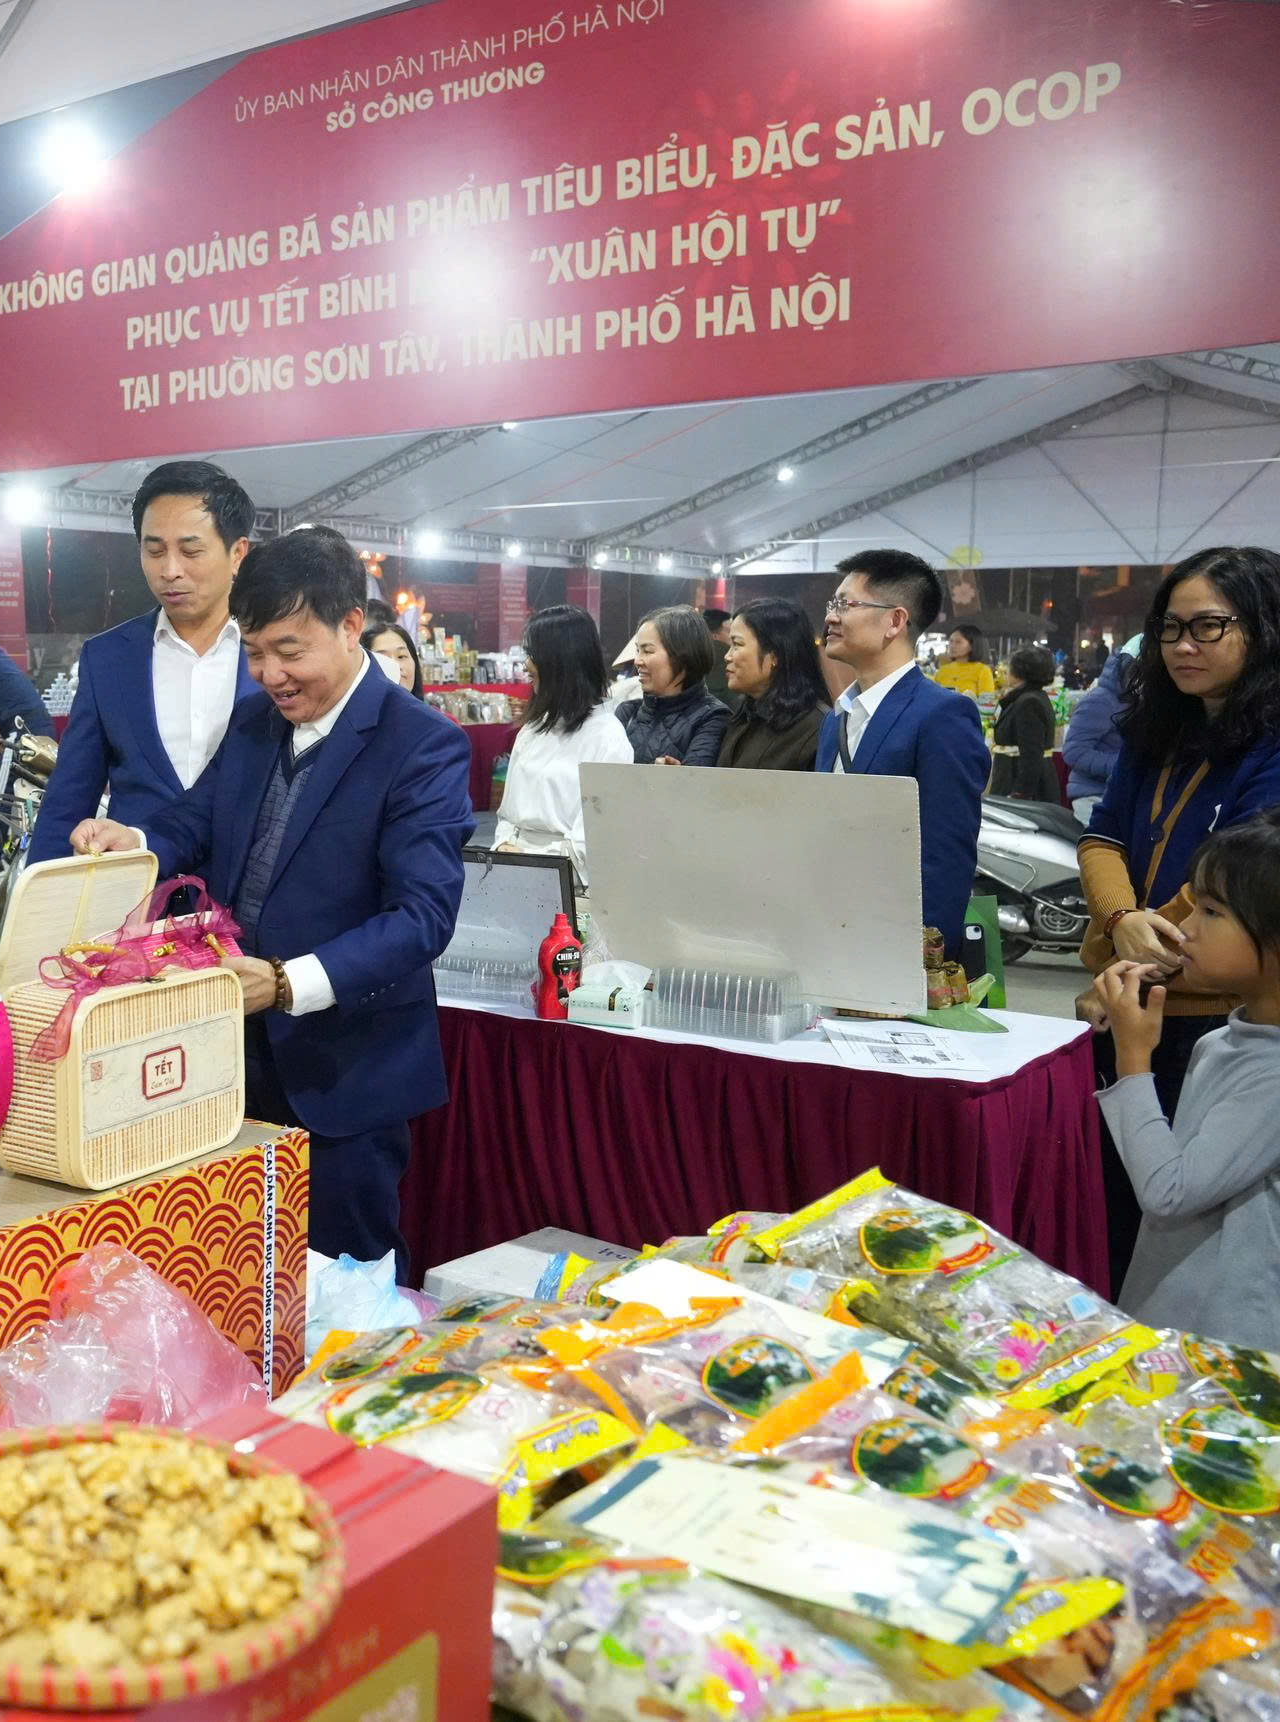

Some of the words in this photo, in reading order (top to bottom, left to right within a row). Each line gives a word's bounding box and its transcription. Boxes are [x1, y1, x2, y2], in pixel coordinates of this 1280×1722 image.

[234, 96, 259, 123] ỦY
[264, 88, 304, 116] BAN
[310, 69, 370, 103] NHÂN
[376, 54, 424, 86] DÂN
[430, 38, 506, 73] THÀNH
[513, 11, 566, 52] PHỐ
[572, 4, 609, 39] HÀ
[326, 101, 356, 132] SỞ
[362, 86, 434, 123] CÔNG
[439, 62, 545, 104] THƯƠNG
[91, 253, 156, 296] GIAN
[164, 231, 268, 285] QUẢNG
[278, 215, 321, 261] BÁ
[330, 201, 395, 251] SẢN
[406, 173, 510, 238] PHẨM
[521, 162, 601, 216] TIÊU
[615, 134, 717, 200] BIỂU,
[730, 119, 820, 180] ĐẶC
[835, 97, 945, 160] SẢN,
[961, 61, 1121, 136] OCOP
[126, 306, 200, 350] PHỤC
[209, 298, 250, 338] VỤ
[258, 277, 308, 329] TẾT
[319, 272, 396, 320] BÍNH
[671, 210, 747, 267] HỘI
[120, 377, 160, 413] TẠI
[169, 356, 294, 405] PHƯỜNG
[304, 343, 370, 387] SƠN
[379, 331, 447, 376] TÂY,
[595, 287, 684, 351] PHỐ
[695, 285, 755, 338] HÀ
[770, 272, 851, 331] NỘI
[556, 951, 580, 961] CHIN-SU
[155, 1056, 173, 1077] TẾT
[264, 1143, 273, 1172] ECAL
[266, 1175, 275, 1202] DÁN
[264, 1205, 274, 1240] CẠNH
[264, 1244, 273, 1270] BỤC
[265, 1272, 273, 1316] VUÔNG
[264, 1319, 272, 1345] ĐỢT
[264, 1360, 271, 1375] KT
[265, 1349, 271, 1358] 2
